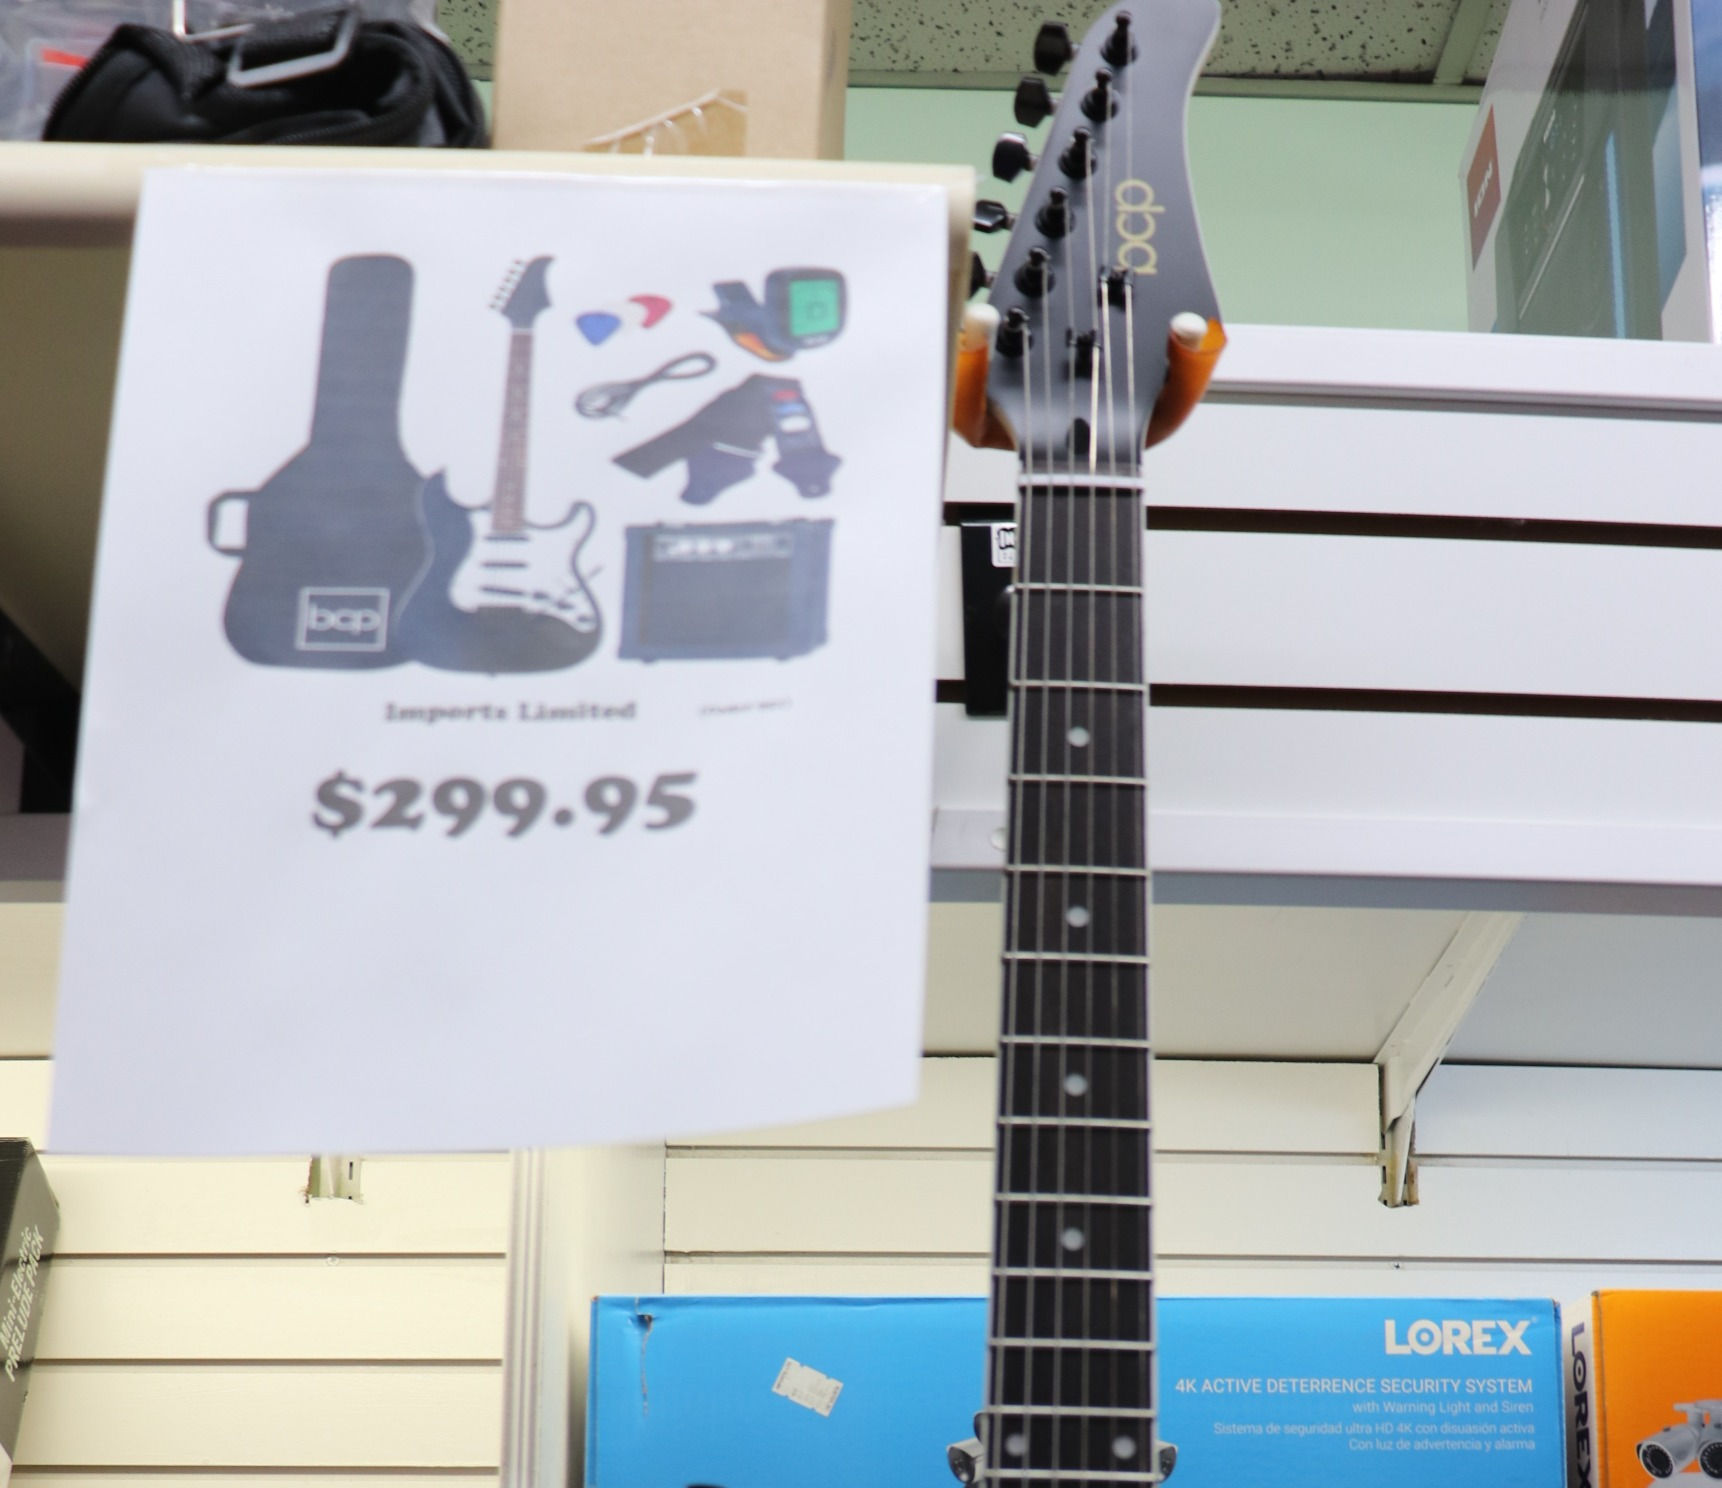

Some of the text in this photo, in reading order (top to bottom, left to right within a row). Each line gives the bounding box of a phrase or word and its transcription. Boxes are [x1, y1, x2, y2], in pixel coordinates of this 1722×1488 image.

[385, 703, 638, 723] Imports Limited
[312, 770, 698, 838] $299.95
[5, 1224, 44, 1383] PRELUDE PACK
[1384, 1319, 1533, 1356] LOREX
[1175, 1378, 1533, 1394] 4K ACTIVE DETERRENCE SECURITY SYSTEM
[1352, 1401, 1534, 1416] with Warning Light and Siren
[1213, 1422, 1263, 1435] Sistema
[1265, 1422, 1281, 1435] de
[1284, 1422, 1343, 1438] seguridad
[1346, 1422, 1373, 1435] ultra
[1375, 1422, 1394, 1434] HD
[1397, 1422, 1412, 1434] 4K
[1415, 1424, 1438, 1434] con
[1499, 1422, 1535, 1435] activa
[1348, 1438, 1536, 1453] Con luz de advertencia y alarma
